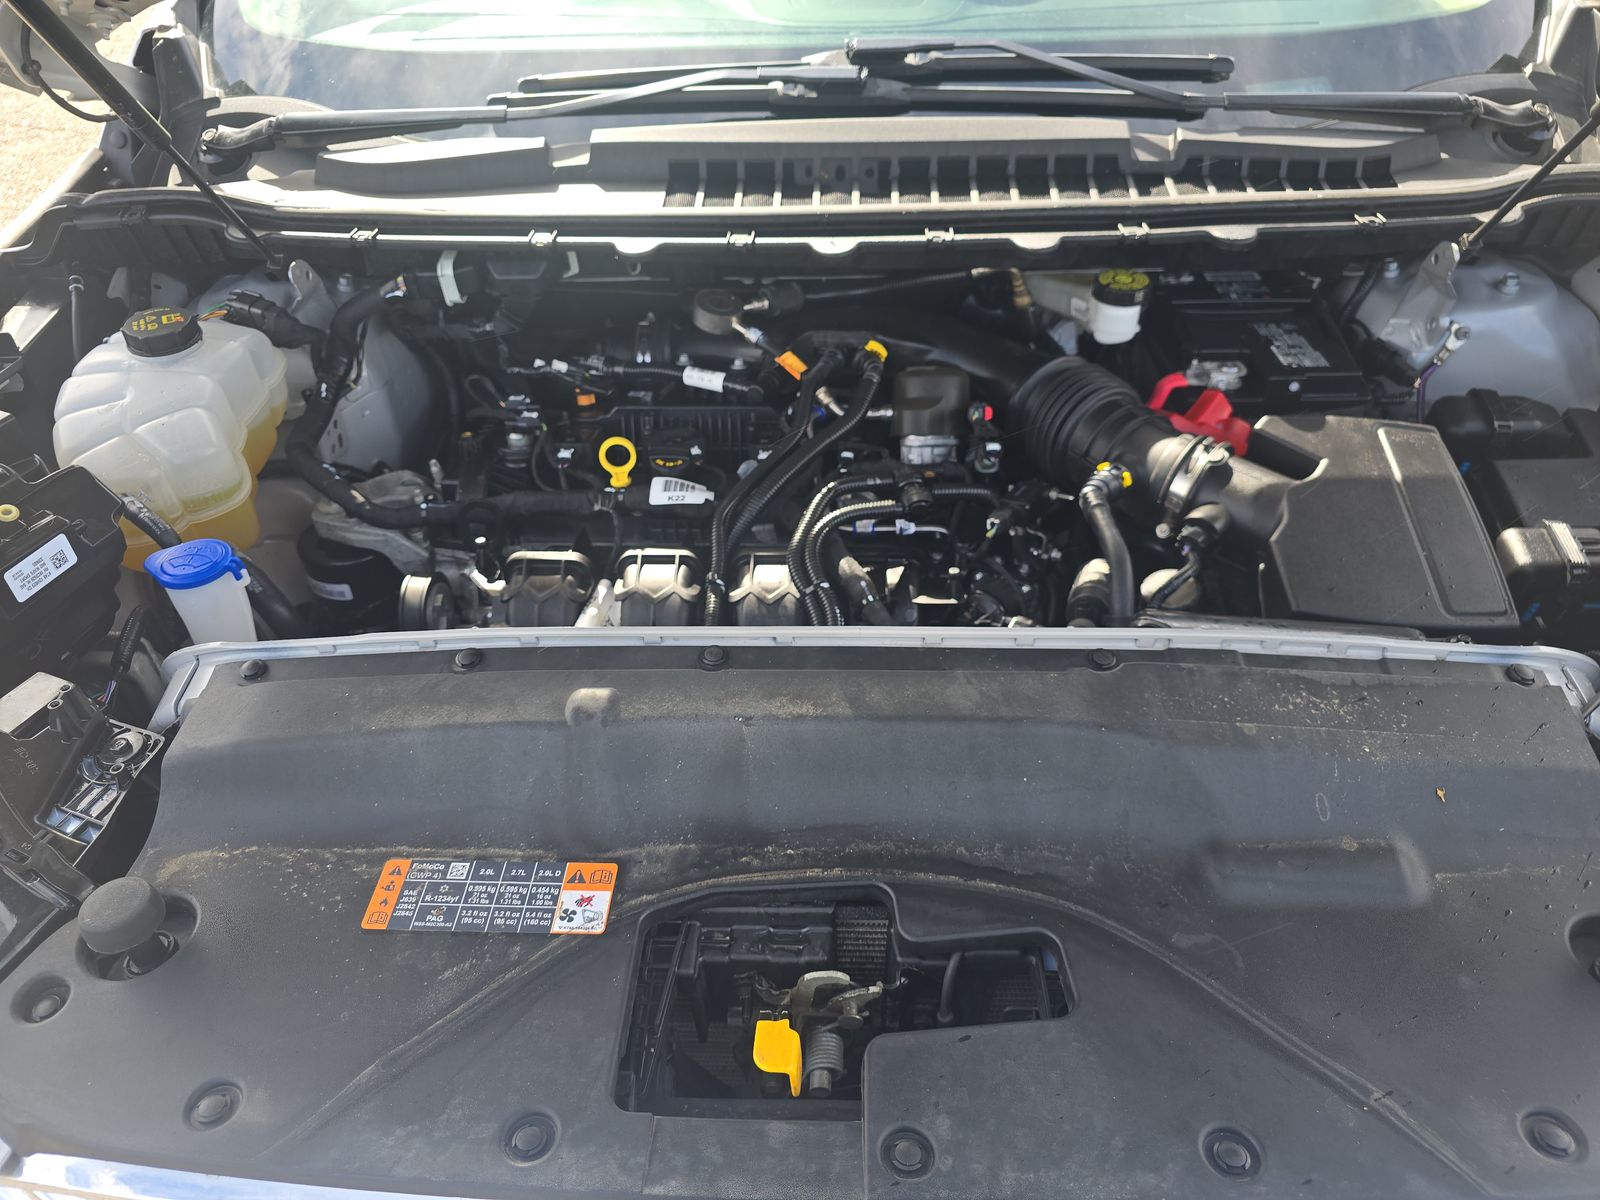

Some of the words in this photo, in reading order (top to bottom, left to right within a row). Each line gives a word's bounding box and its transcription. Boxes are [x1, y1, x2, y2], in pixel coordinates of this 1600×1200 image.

[412, 862, 445, 870] FoMoCo
[486, 886, 497, 894] kg
[550, 887, 560, 895] kg
[424, 895, 459, 904] R-1234yf
[505, 918, 517, 926] cc)
